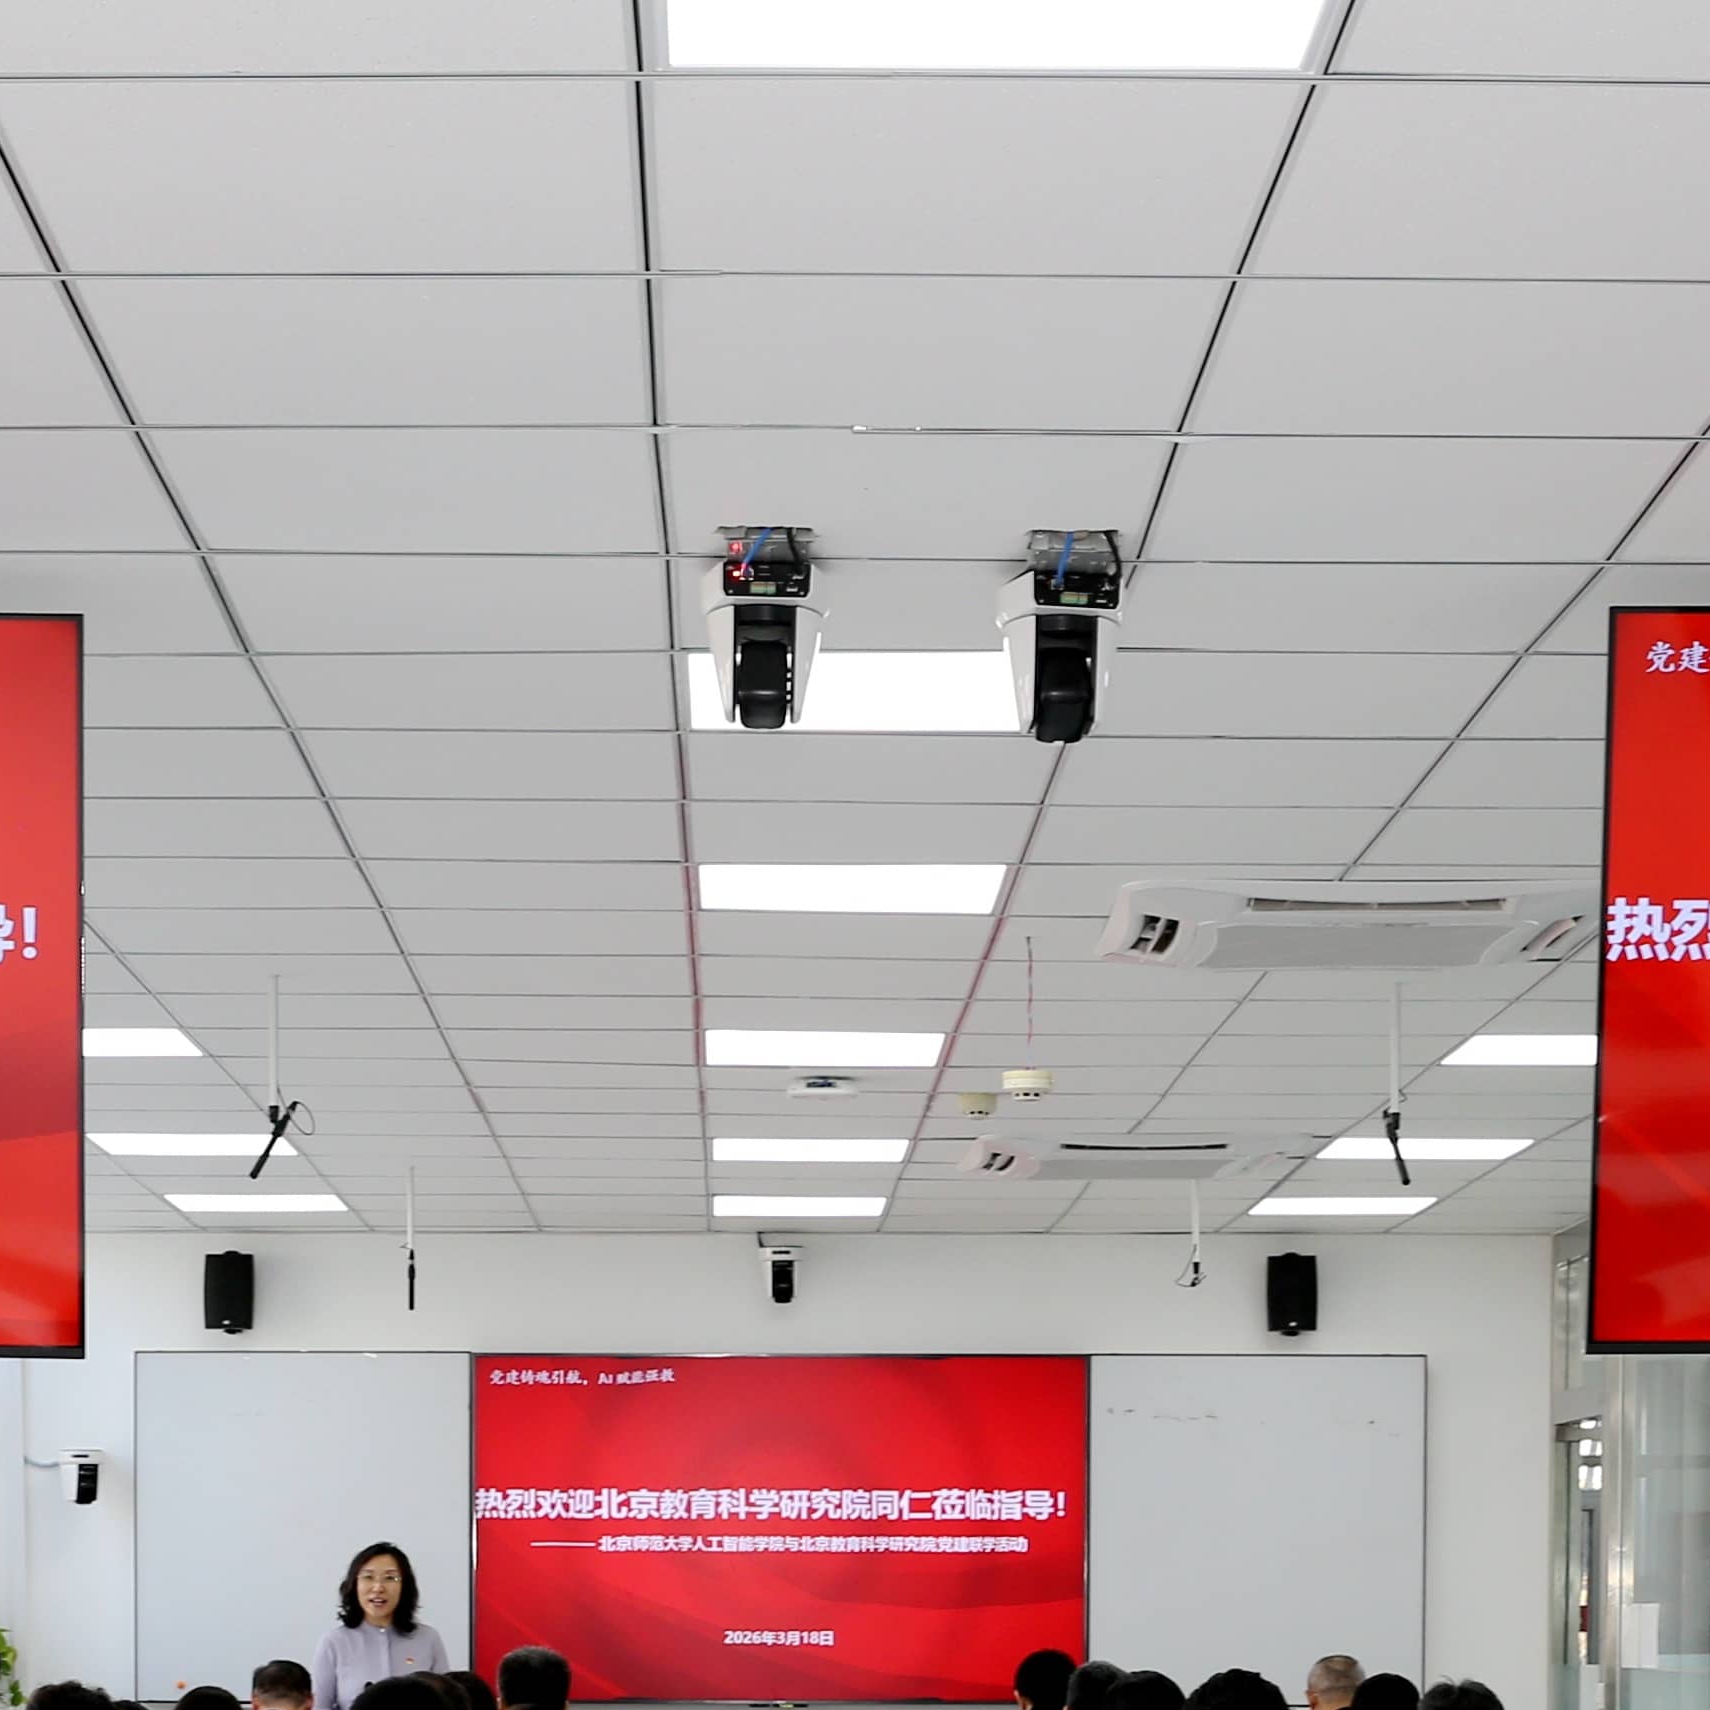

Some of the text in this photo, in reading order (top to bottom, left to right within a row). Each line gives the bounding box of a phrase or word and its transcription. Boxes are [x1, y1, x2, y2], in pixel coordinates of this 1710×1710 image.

[474, 1487, 1066, 1521] 热烈欢迎北京教育科学研究院同仁莅临指导！
[722, 1630, 835, 1647] 2026年3月18日
